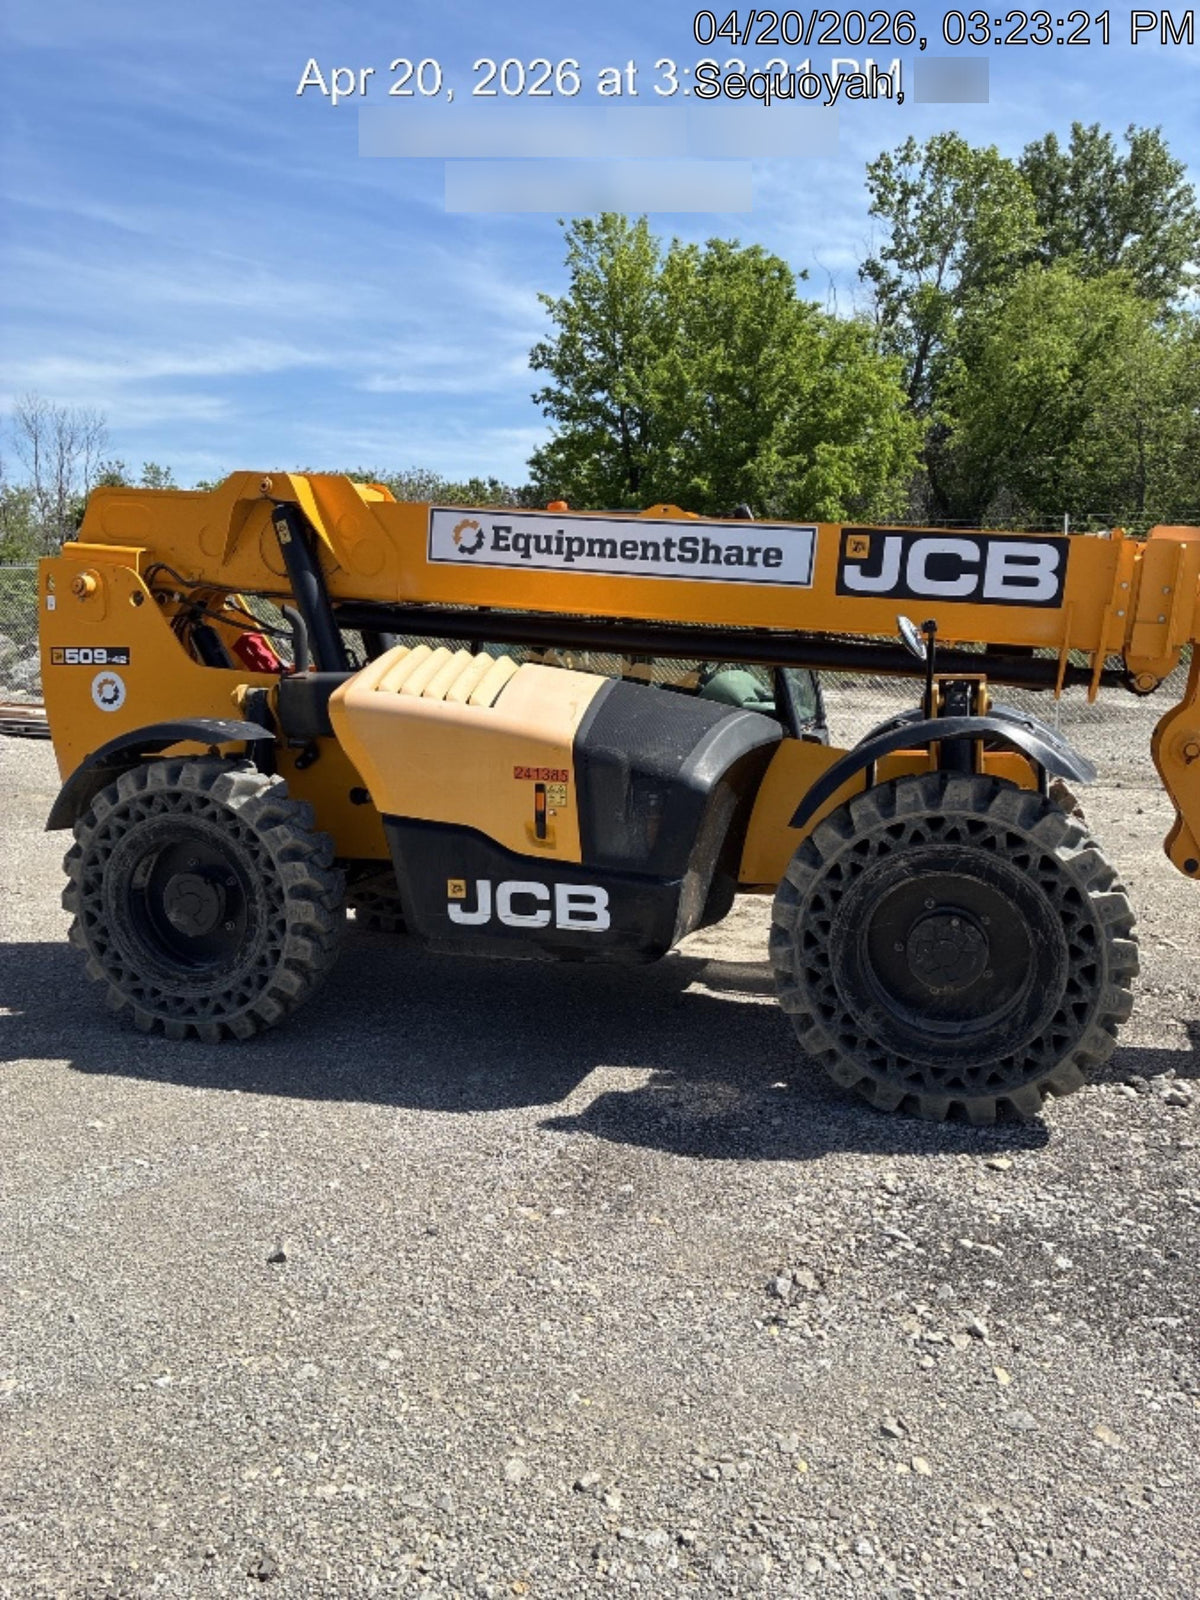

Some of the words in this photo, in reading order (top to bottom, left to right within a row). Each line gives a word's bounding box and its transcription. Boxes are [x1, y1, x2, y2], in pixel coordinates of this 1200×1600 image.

[490, 525, 784, 569] EquipmentShare
[843, 536, 1061, 601] JCB
[513, 767, 569, 783] 241385
[447, 879, 611, 933] JCB
